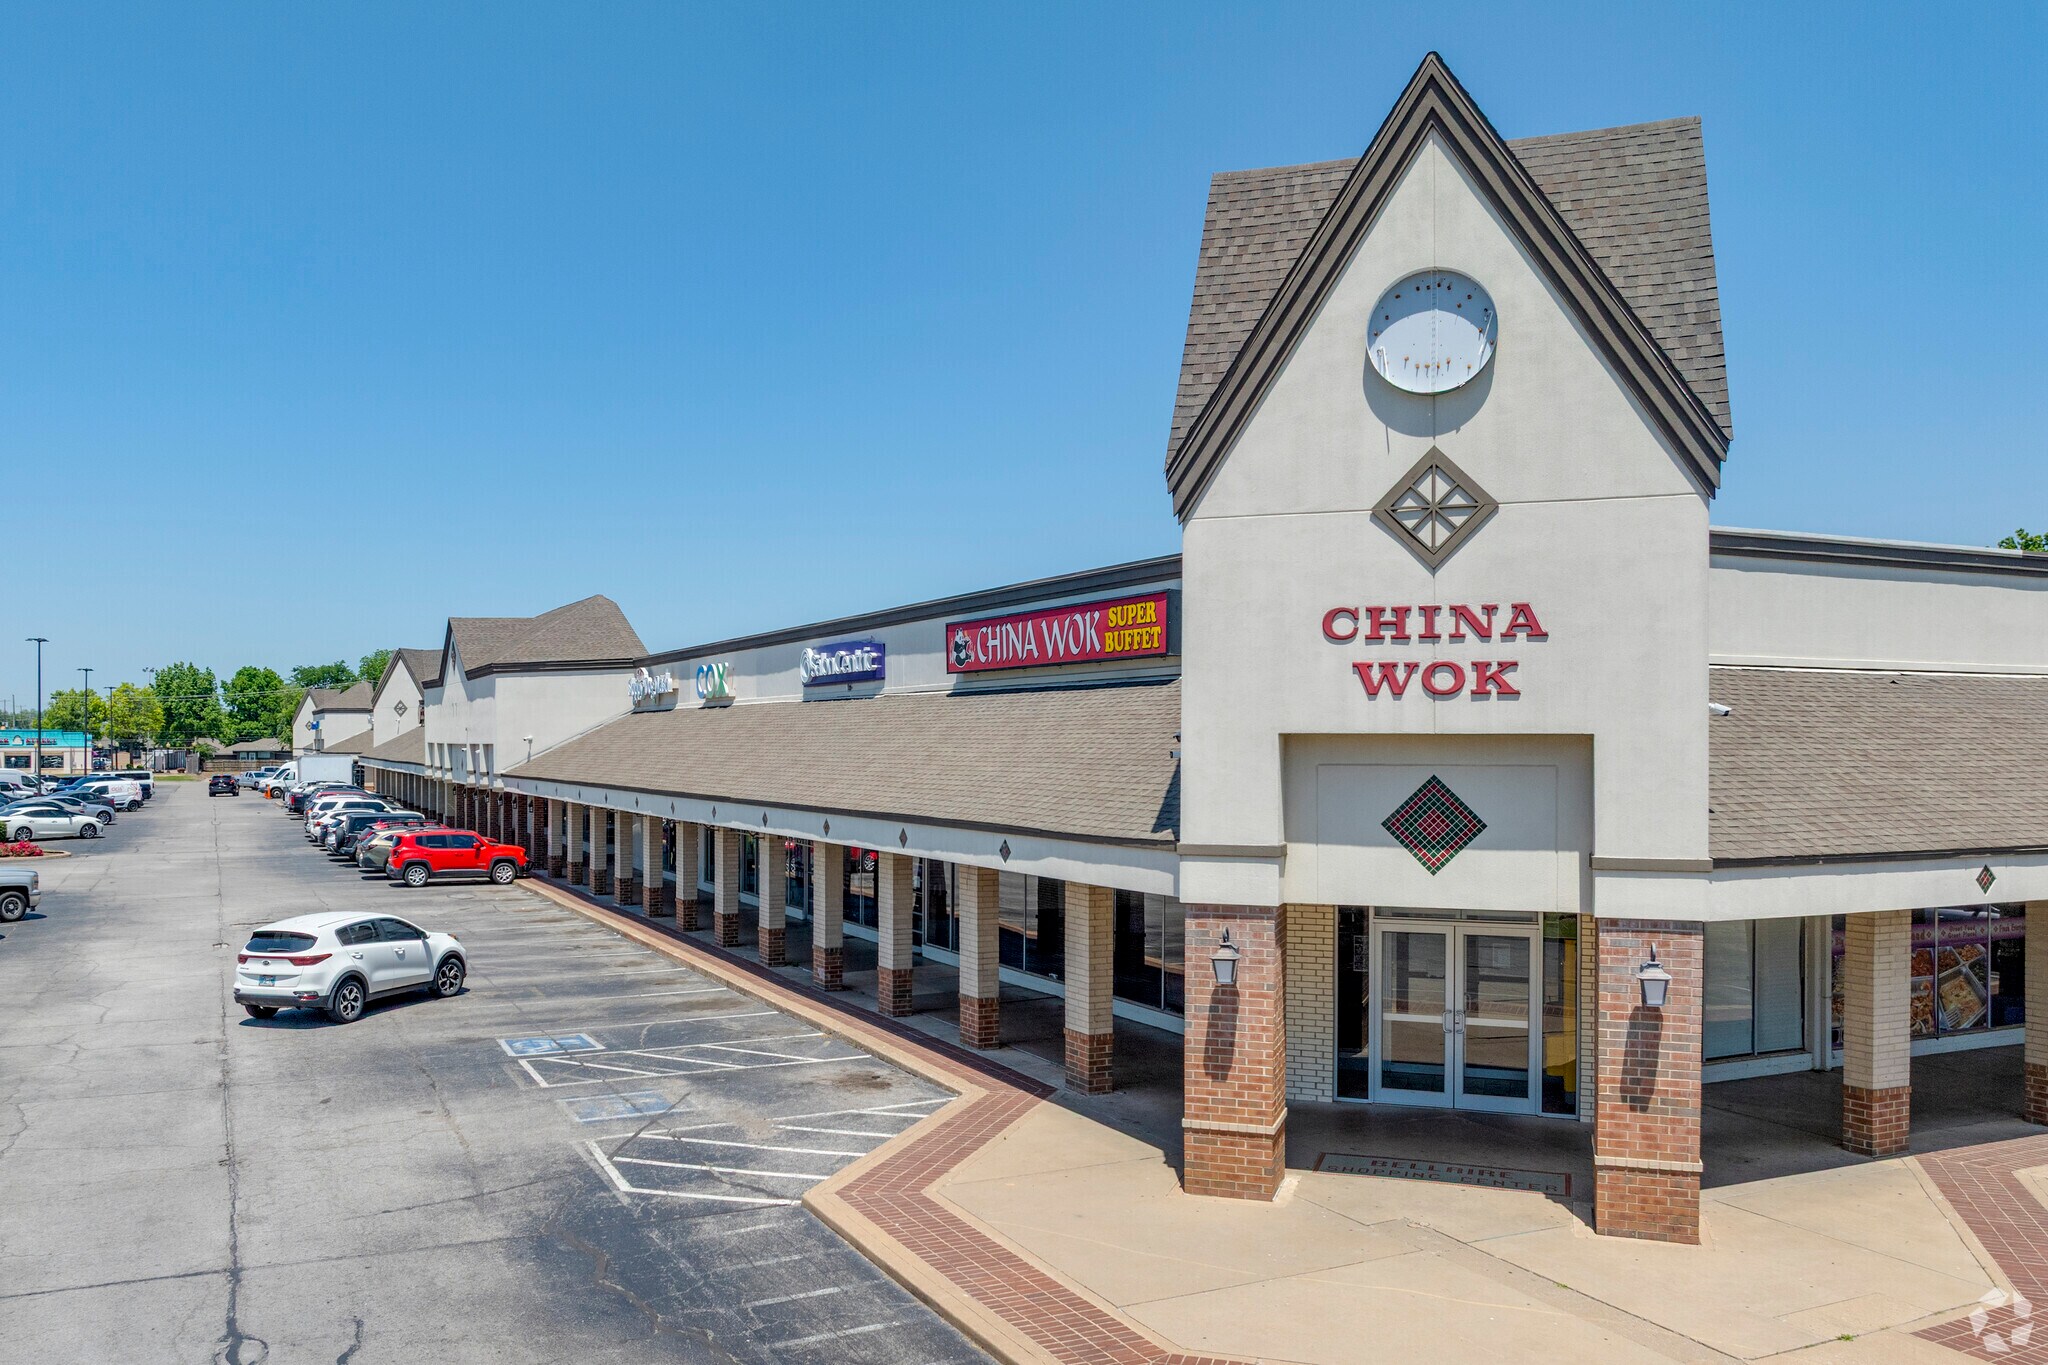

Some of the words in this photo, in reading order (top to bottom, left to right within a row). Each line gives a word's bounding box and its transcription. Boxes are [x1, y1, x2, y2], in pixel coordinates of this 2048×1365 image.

[1108, 601, 1157, 627] SUPER
[1322, 603, 1549, 640] CHINA
[977, 620, 1039, 663] CHINA
[1040, 610, 1101, 659] WOK
[1105, 627, 1161, 653] BUFFET
[696, 662, 729, 699] COX
[1352, 661, 1521, 696] WOK
[1326, 1165, 1441, 1180] SHOPPING
[1459, 1176, 1559, 1193] CENTER
[1371, 1159, 1513, 1179] BELLAIRE
